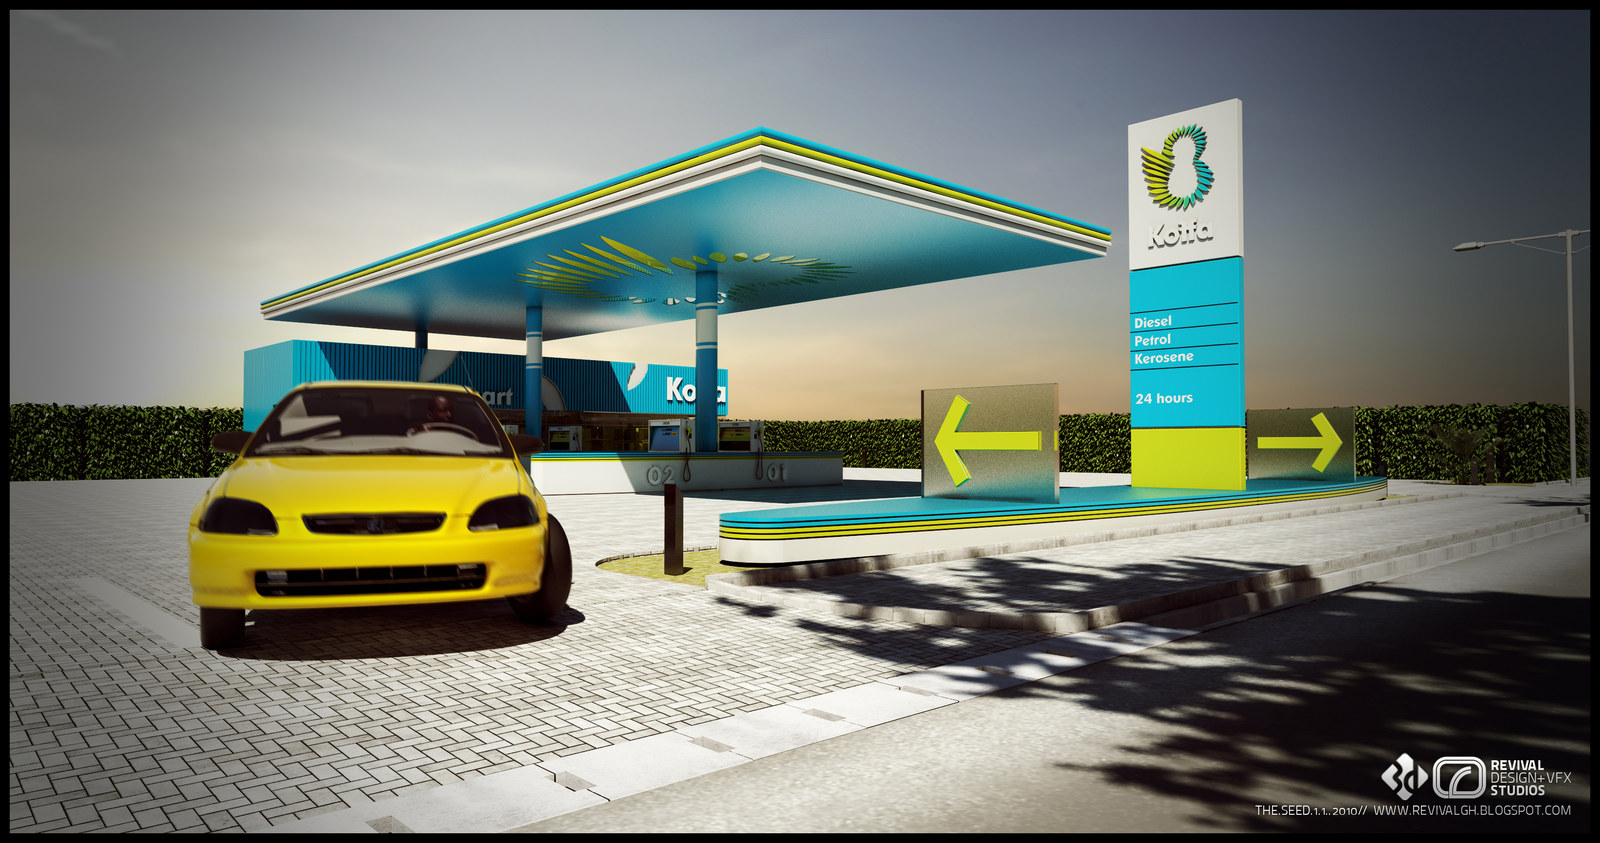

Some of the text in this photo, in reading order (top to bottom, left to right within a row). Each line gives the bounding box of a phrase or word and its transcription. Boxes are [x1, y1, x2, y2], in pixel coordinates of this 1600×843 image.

[1134, 314, 1172, 329] Diesel
[1134, 333, 1171, 347] Petrol
[1134, 352, 1194, 365] Kerosene
[482, 387, 514, 405] art
[1135, 392, 1194, 405] 24 hours
